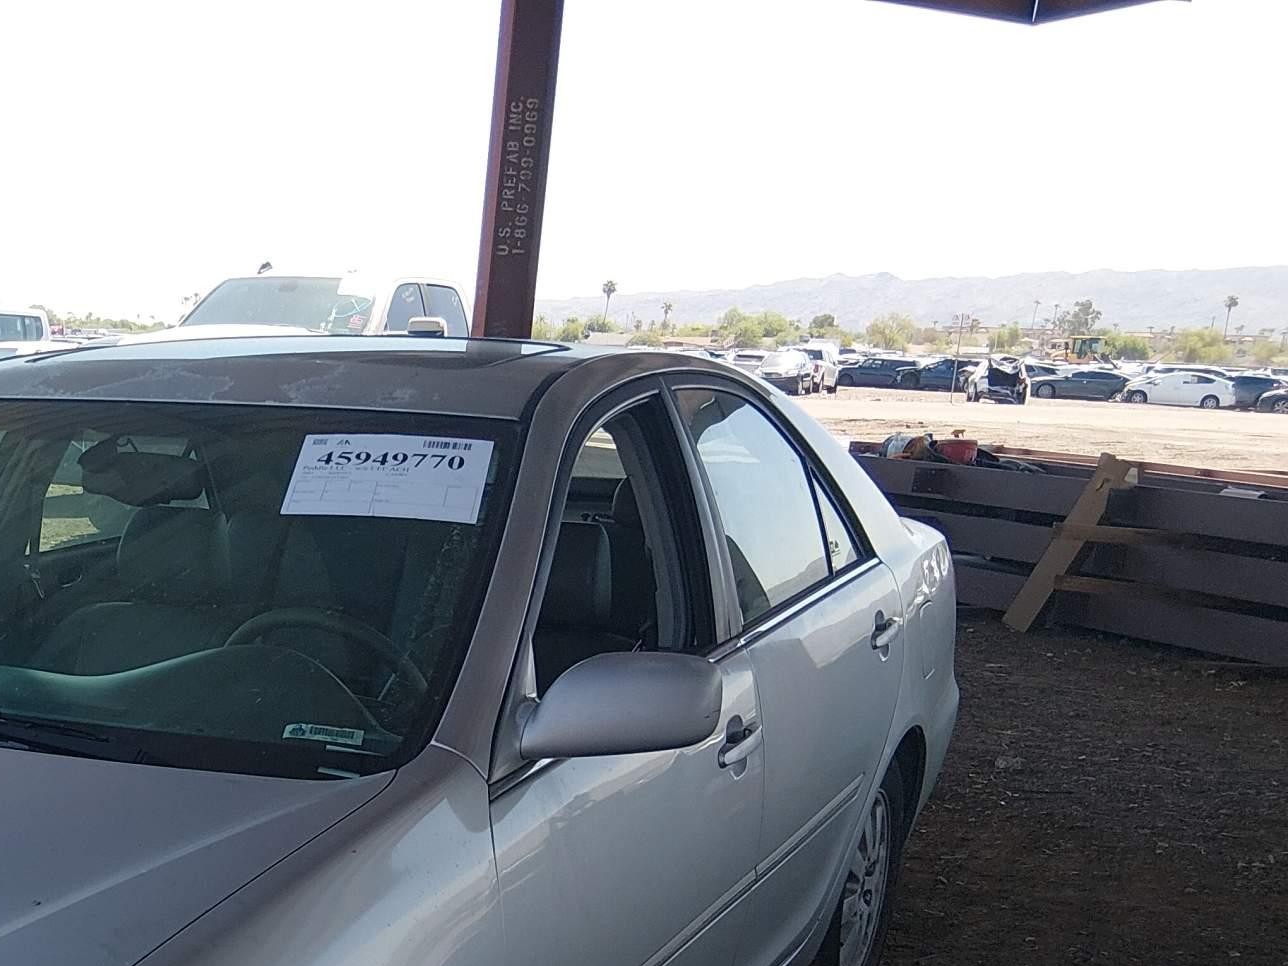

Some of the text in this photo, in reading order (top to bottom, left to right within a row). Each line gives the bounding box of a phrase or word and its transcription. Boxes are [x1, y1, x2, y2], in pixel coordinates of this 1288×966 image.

[495, 96, 524, 256] U.S. PREFAB INC.
[316, 450, 466, 471] 45949770
